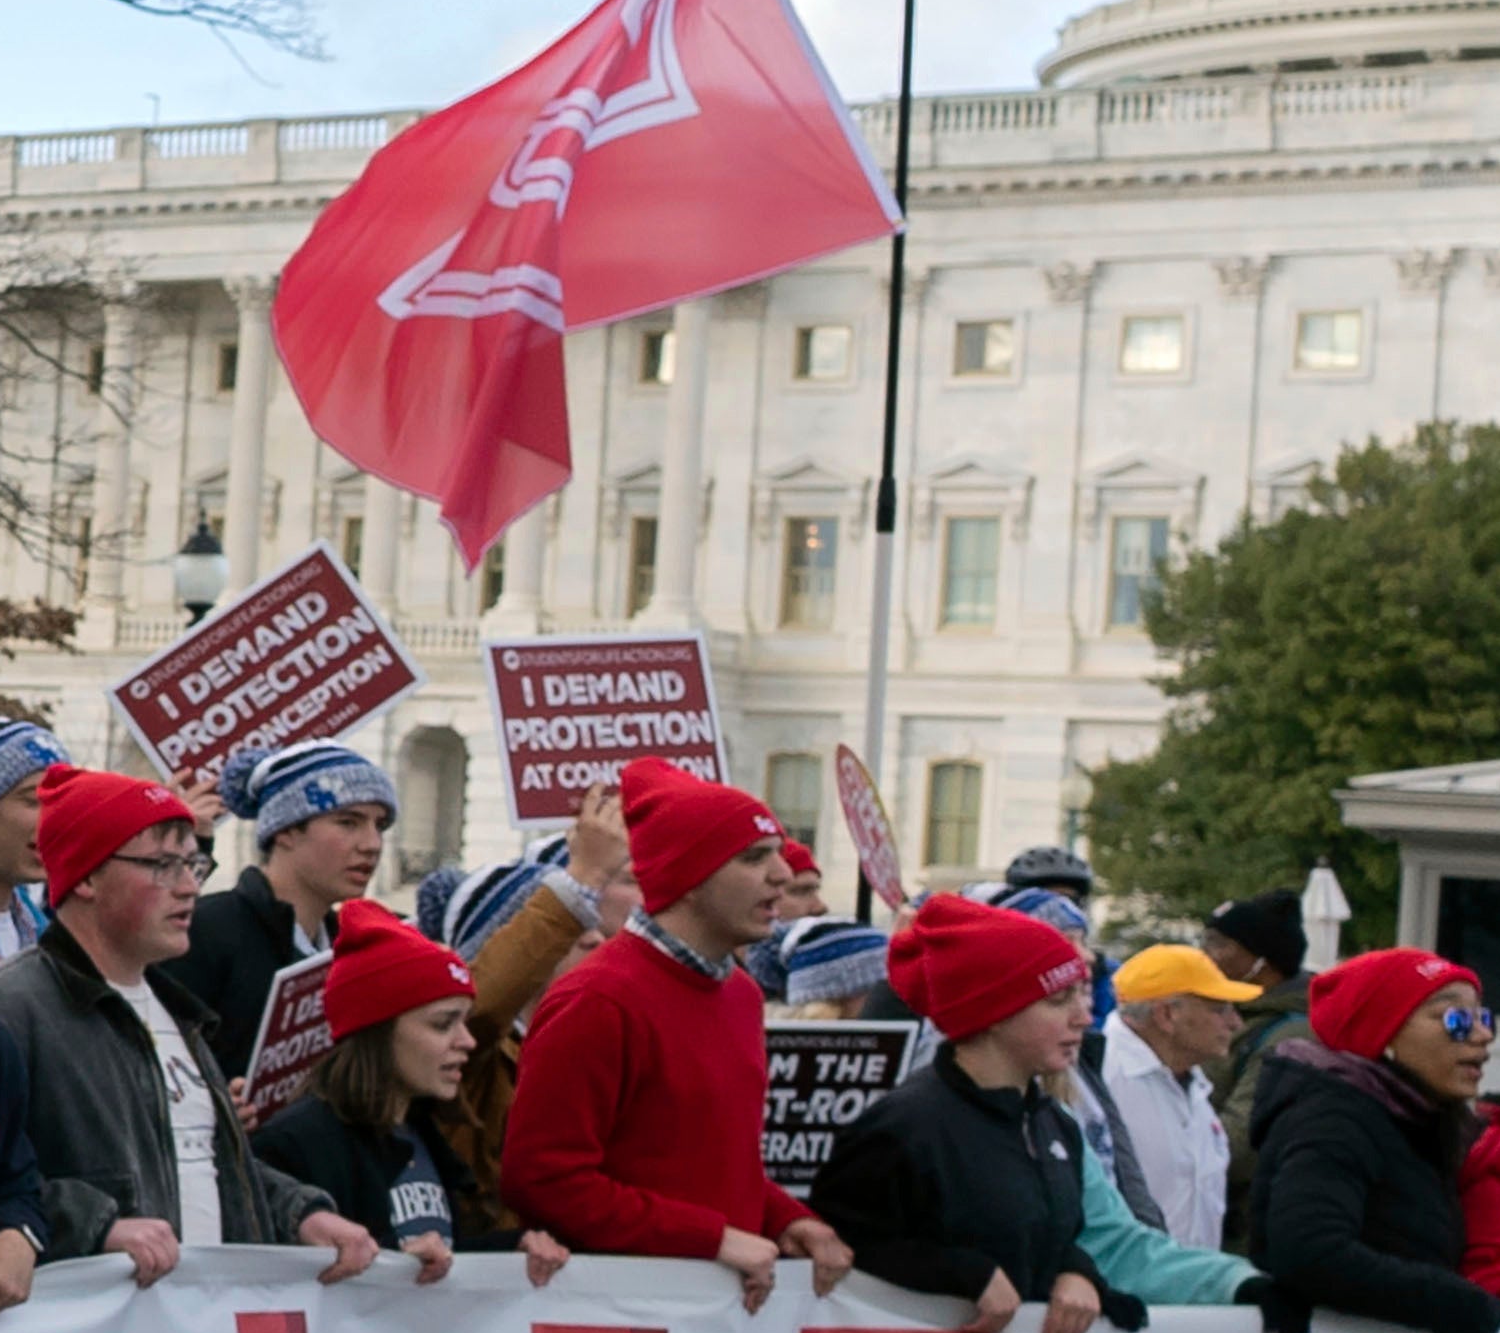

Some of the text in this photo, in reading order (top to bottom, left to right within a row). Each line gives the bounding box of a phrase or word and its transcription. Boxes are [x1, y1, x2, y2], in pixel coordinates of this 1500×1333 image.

[156, 590, 329, 721] I DEMAND
[156, 604, 378, 768] PROTECTION
[520, 669, 686, 708] I DEMAND
[505, 710, 715, 753] PROTECTION
[521, 762, 553, 791] AT
[296, 987, 325, 1026] DE
[815, 1053, 889, 1083] THE
[389, 1181, 452, 1227] IBER
